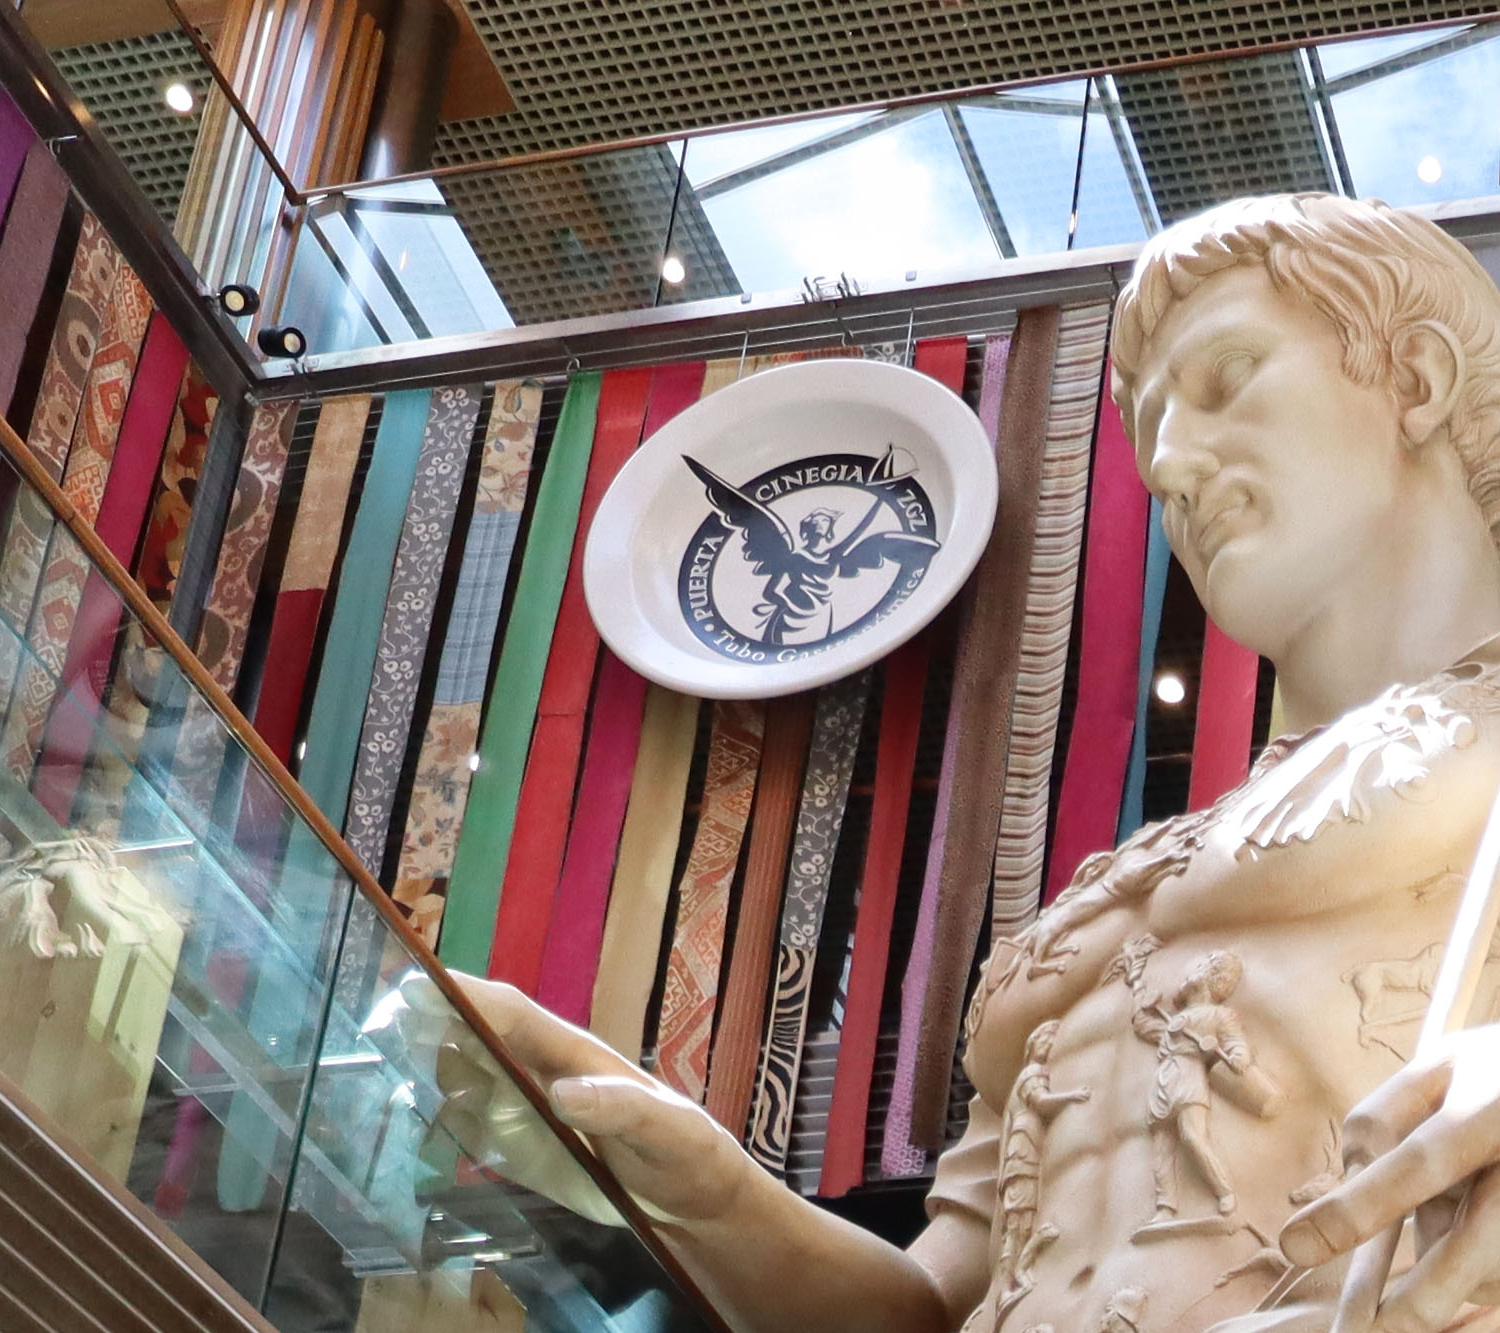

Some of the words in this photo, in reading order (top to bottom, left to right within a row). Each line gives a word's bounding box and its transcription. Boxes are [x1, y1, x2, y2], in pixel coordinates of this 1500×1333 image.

[755, 464, 864, 501] CINEGIA
[896, 489, 928, 532] ZGZ
[688, 536, 725, 622] PUERTA
[713, 631, 765, 662] Tubo
